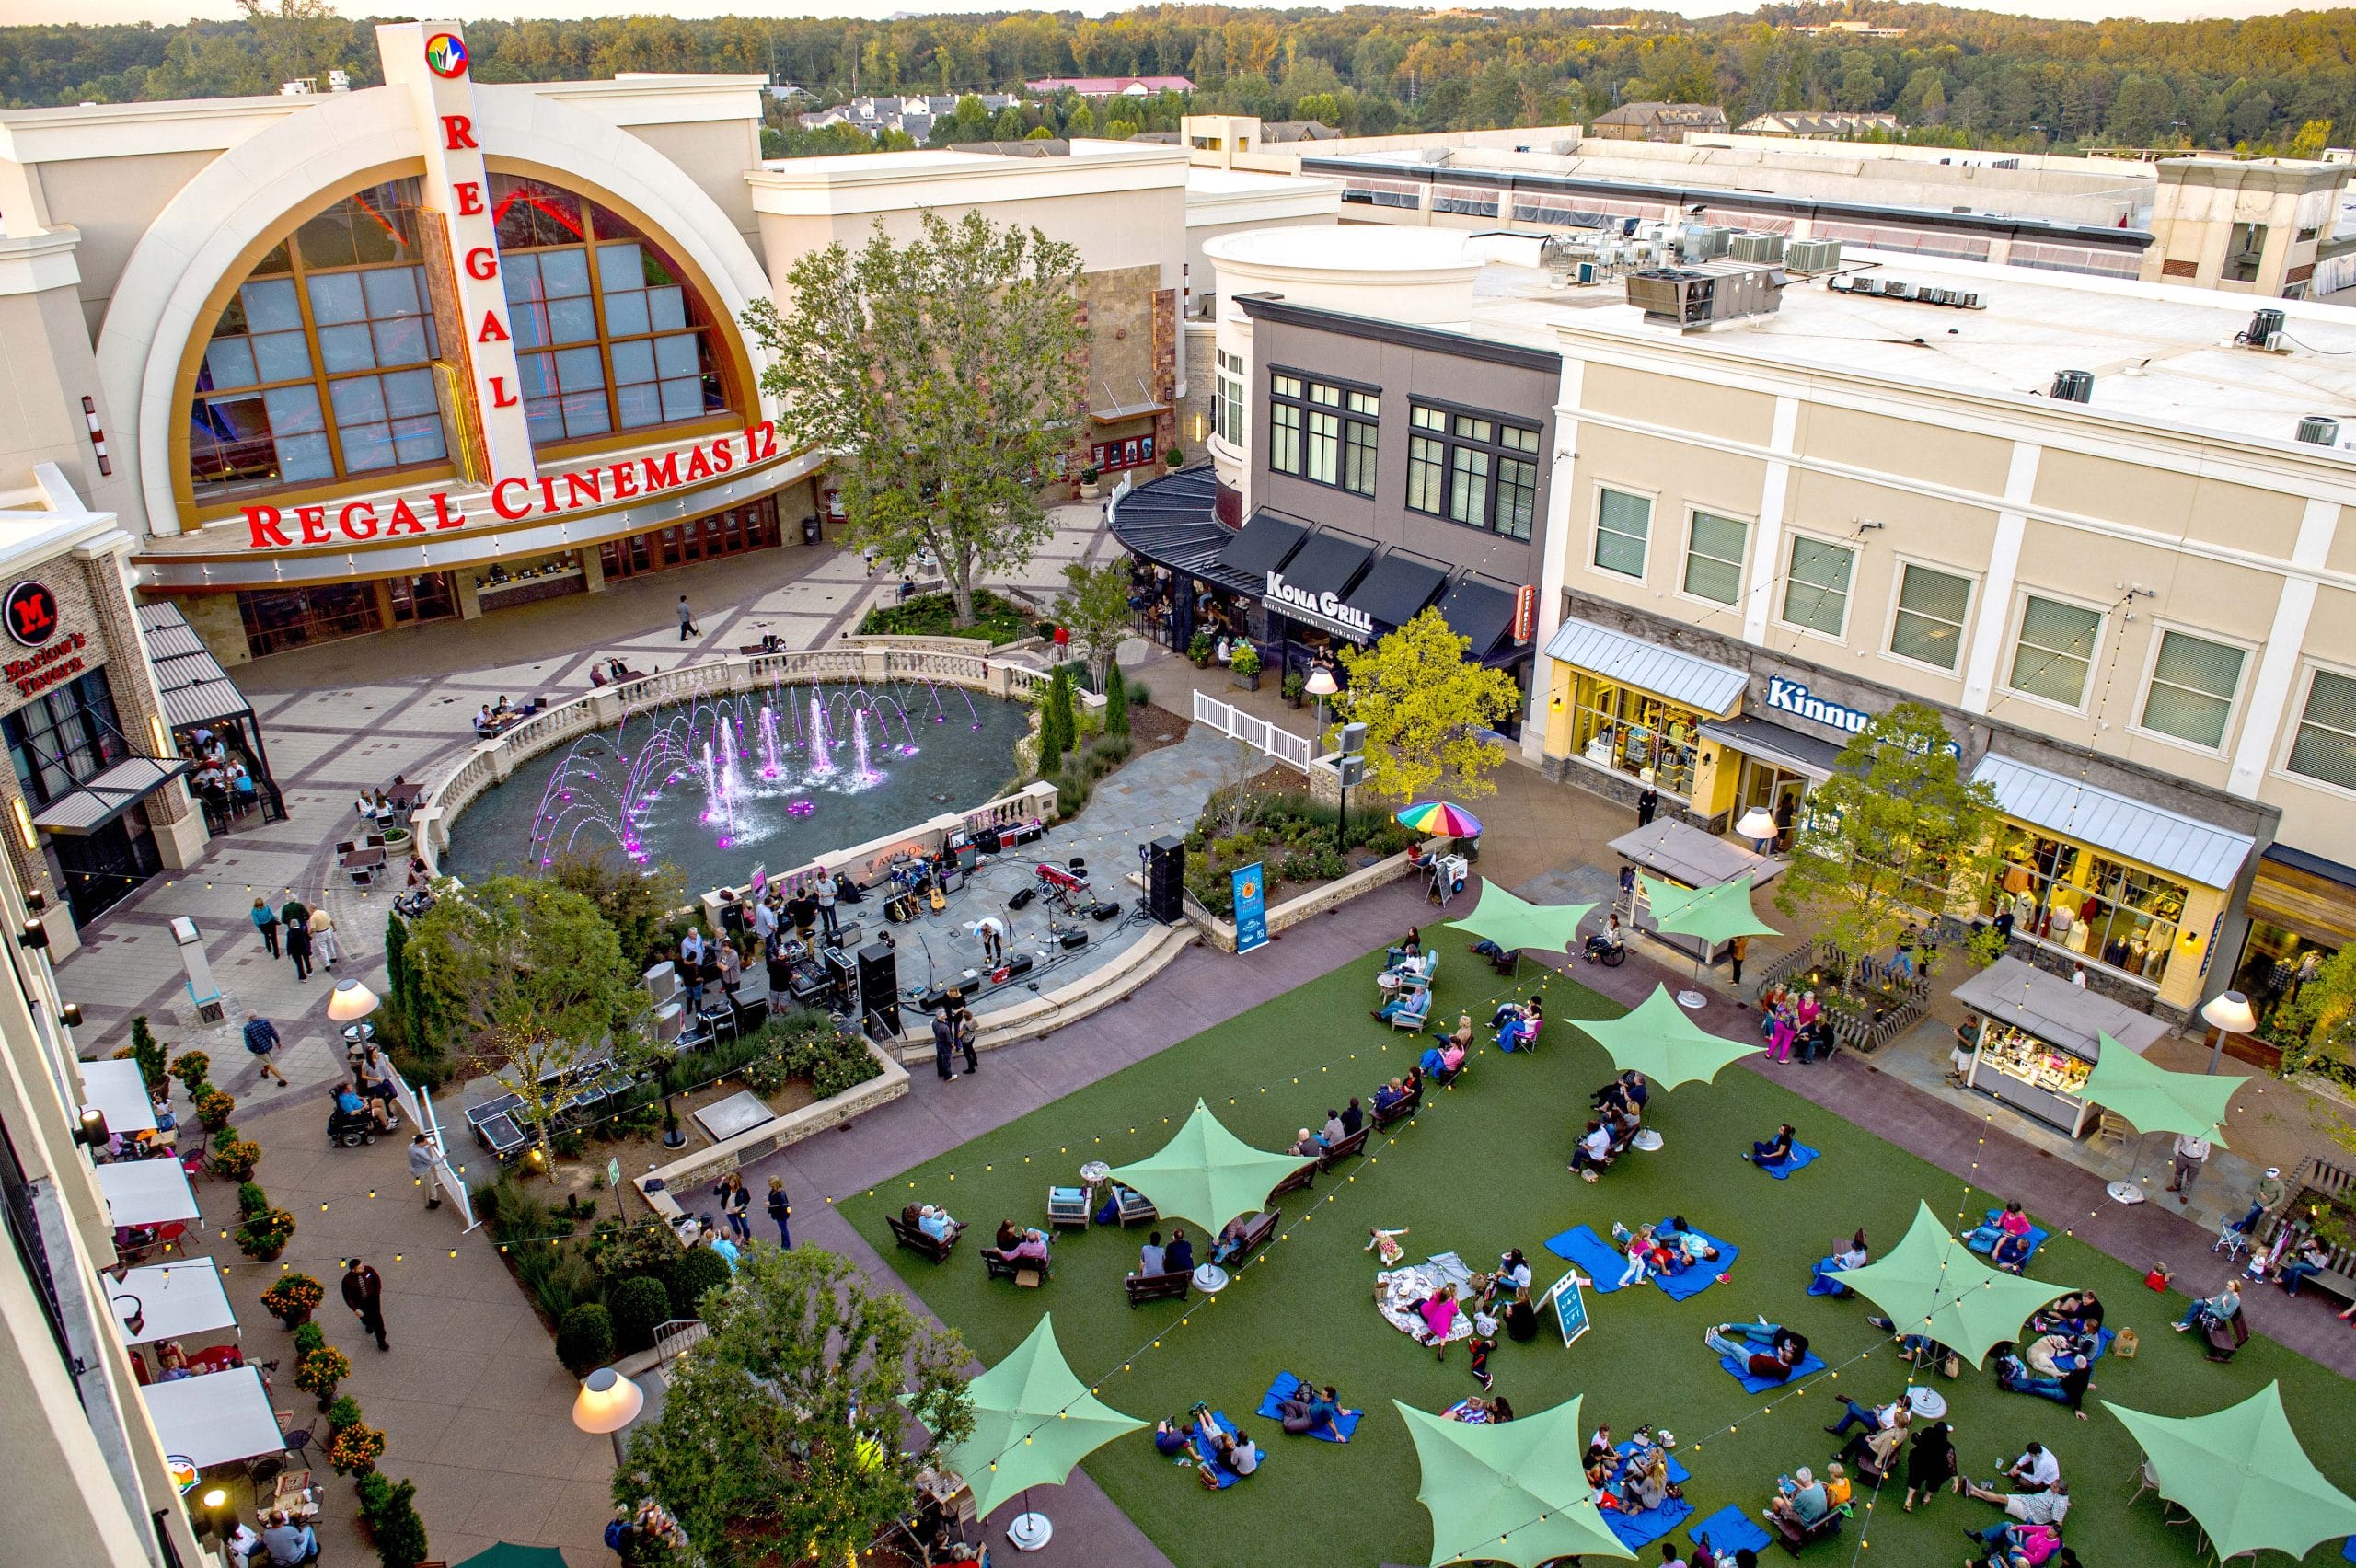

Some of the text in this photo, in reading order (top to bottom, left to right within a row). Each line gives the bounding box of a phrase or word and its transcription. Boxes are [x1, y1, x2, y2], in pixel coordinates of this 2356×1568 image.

[441, 114, 517, 409] REGAL
[239, 420, 778, 549] REGAL CINEMAS 12
[1266, 571, 1374, 631] KONA GRILL
[4, 632, 87, 683] Marlow's
[18, 656, 85, 698] Tavern
[878, 844, 925, 866] AVALON
